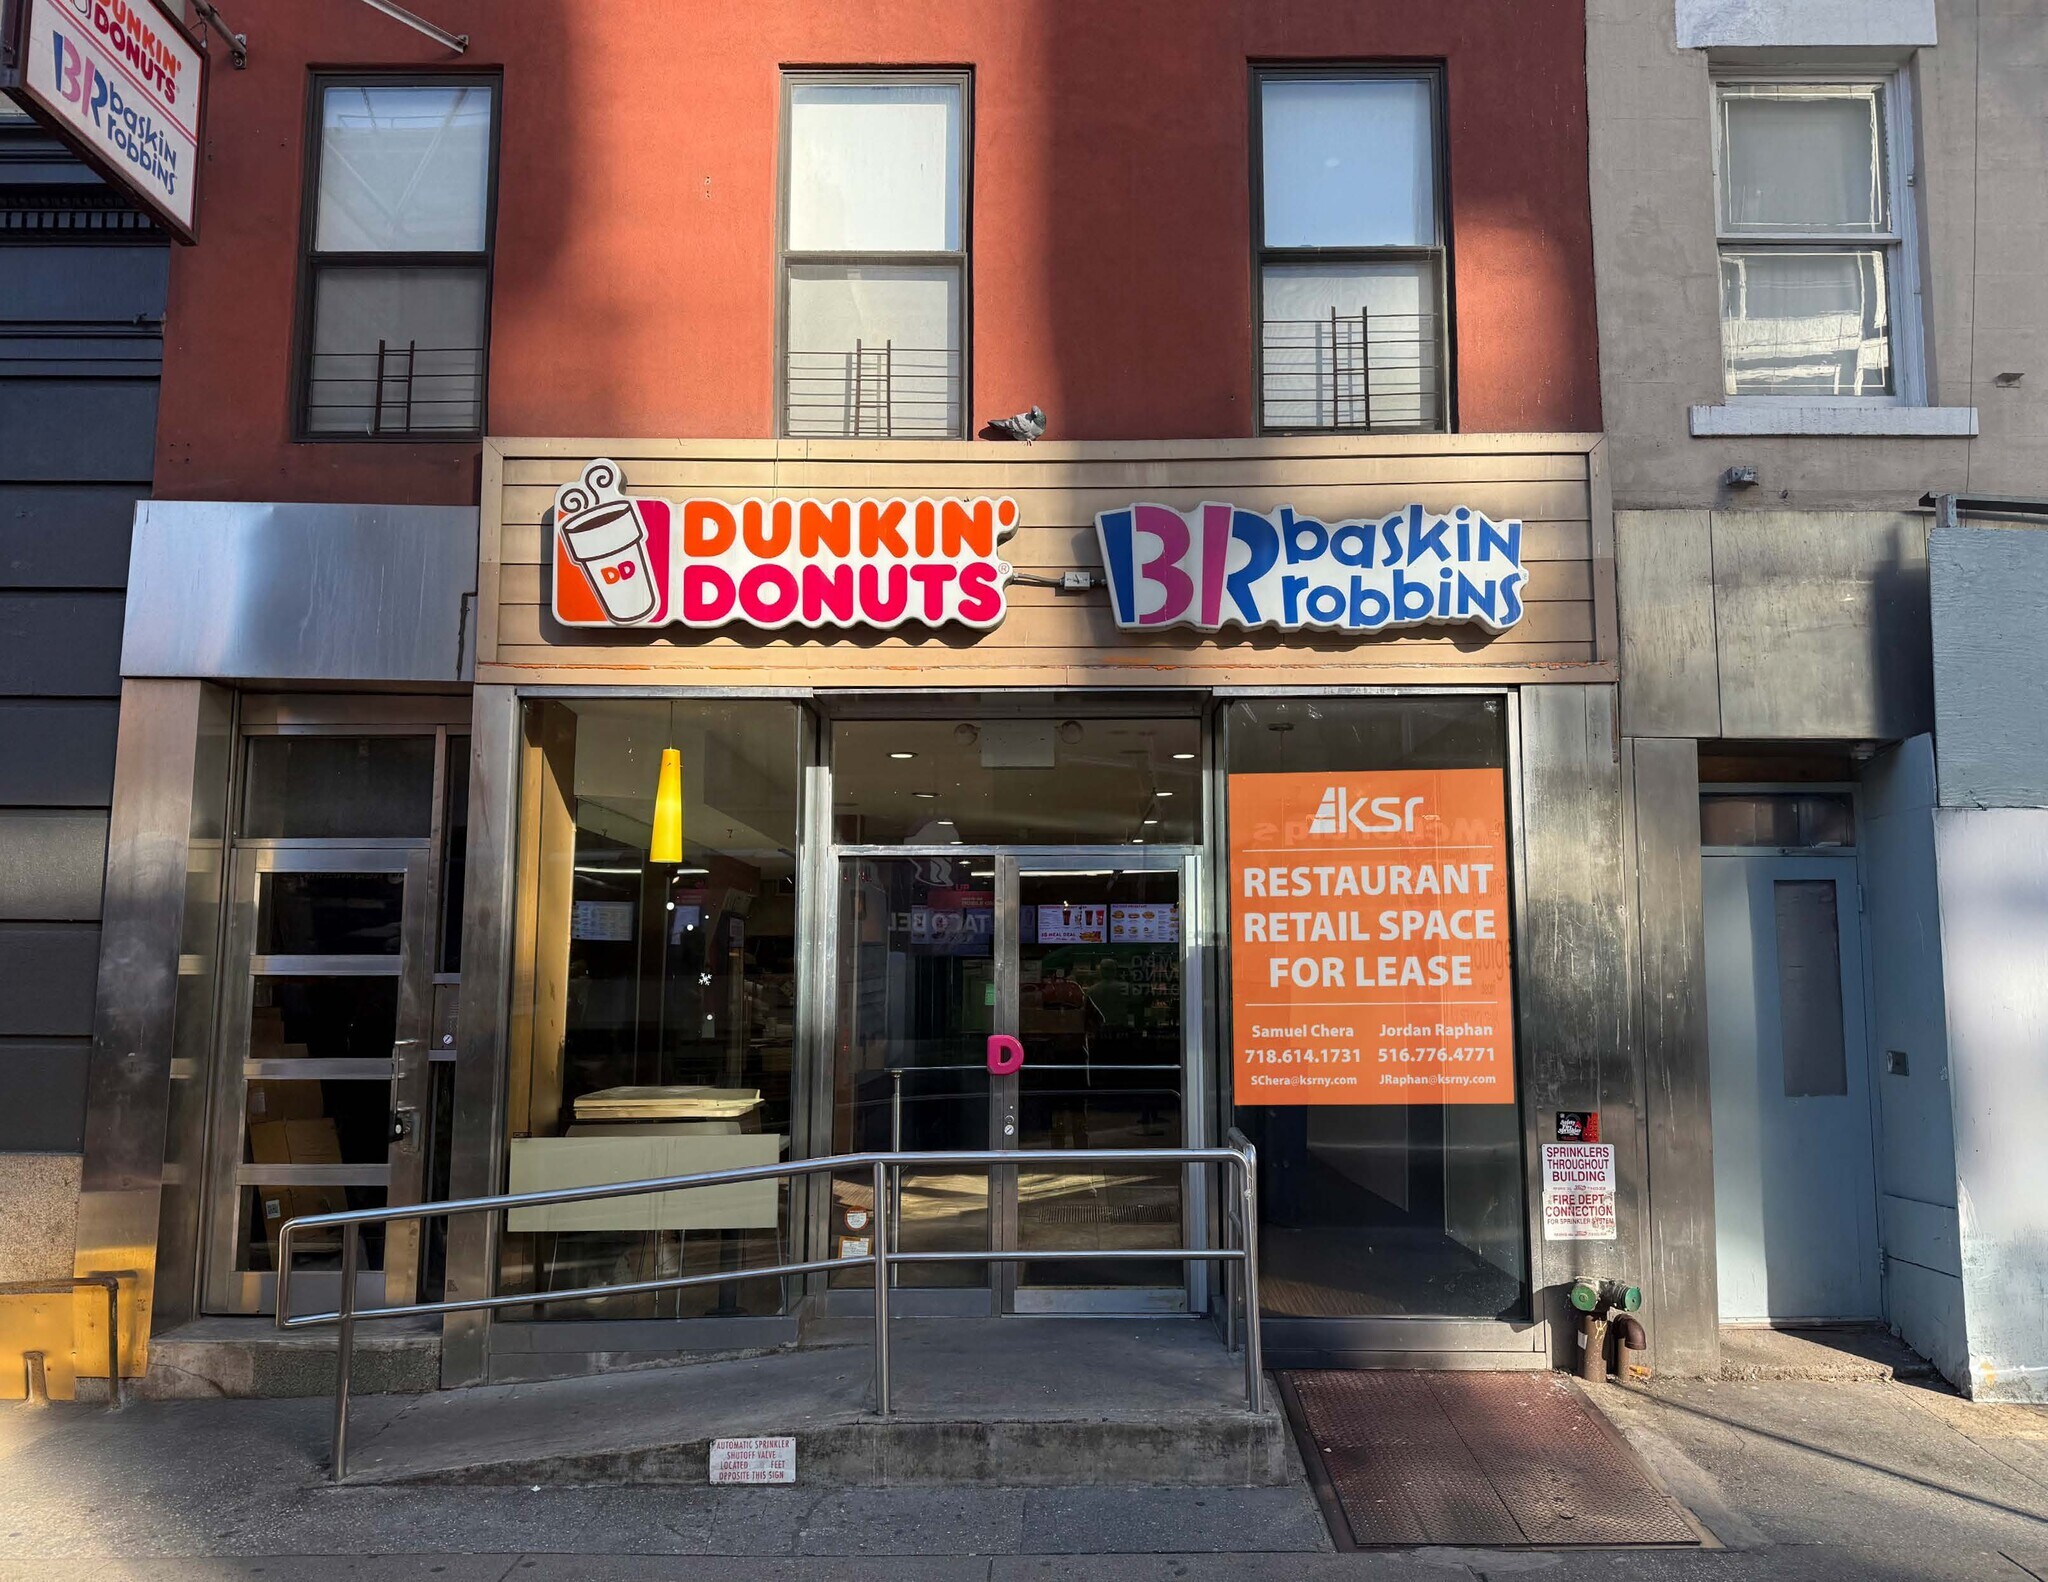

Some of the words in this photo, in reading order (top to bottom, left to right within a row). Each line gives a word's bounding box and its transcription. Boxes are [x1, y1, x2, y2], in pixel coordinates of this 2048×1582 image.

[98, 0, 182, 79] UNKIN'
[94, 2, 175, 105] DONUTS
[53, 30, 108, 128] BR
[109, 81, 176, 171] baskin
[107, 113, 176, 196] robbins
[683, 500, 1015, 558] DUNKIN'
[1280, 504, 1521, 570] baskin
[601, 564, 635, 585] DD
[1100, 505, 1280, 625] BR
[683, 562, 1001, 622] DONUTS
[1281, 567, 1522, 627] robbins
[1243, 864, 1494, 898] RESTAURANT
[1244, 911, 1371, 942] RETAIL
[1379, 909, 1496, 941] SPACE
[1269, 957, 1346, 988] FOR
[1355, 955, 1473, 987] LEASE
[1251, 1023, 1308, 1038] Samuel
[1311, 1024, 1354, 1038] Chera
[1379, 1023, 1432, 1037] Jordan
[1435, 1023, 1493, 1040] Raphan
[987, 1034, 1024, 1075] D
[1245, 1049, 1361, 1064] 718.614.1731
[1377, 1047, 1495, 1062] 516.776.4771
[1250, 1074, 1357, 1087] SChera@ksrny.com
[1379, 1073, 1496, 1087] JRaphan@ksrny.com
[1546, 1146, 1610, 1158] SPRINKLERS
[1547, 1159, 1609, 1170] THROUGHOUT
[1552, 1171, 1606, 1182] BUILDING
[1552, 1194, 1576, 1205] FIRE
[1578, 1194, 1604, 1205] DEPT
[1545, 1205, 1613, 1217] CONNECTION
[716, 1440, 753, 1450] AUTOMATIC
[754, 1439, 790, 1449] SPRINKLER
[727, 1451, 755, 1460] SHUTOFF
[757, 1450, 776, 1459] VALVE
[720, 1461, 749, 1470] LOCATED
[770, 1460, 785, 1469] FEET
[719, 1471, 750, 1480] OPPOSITE
[752, 1471, 767, 1480] THIS
[769, 1470, 784, 1479] SIGN
